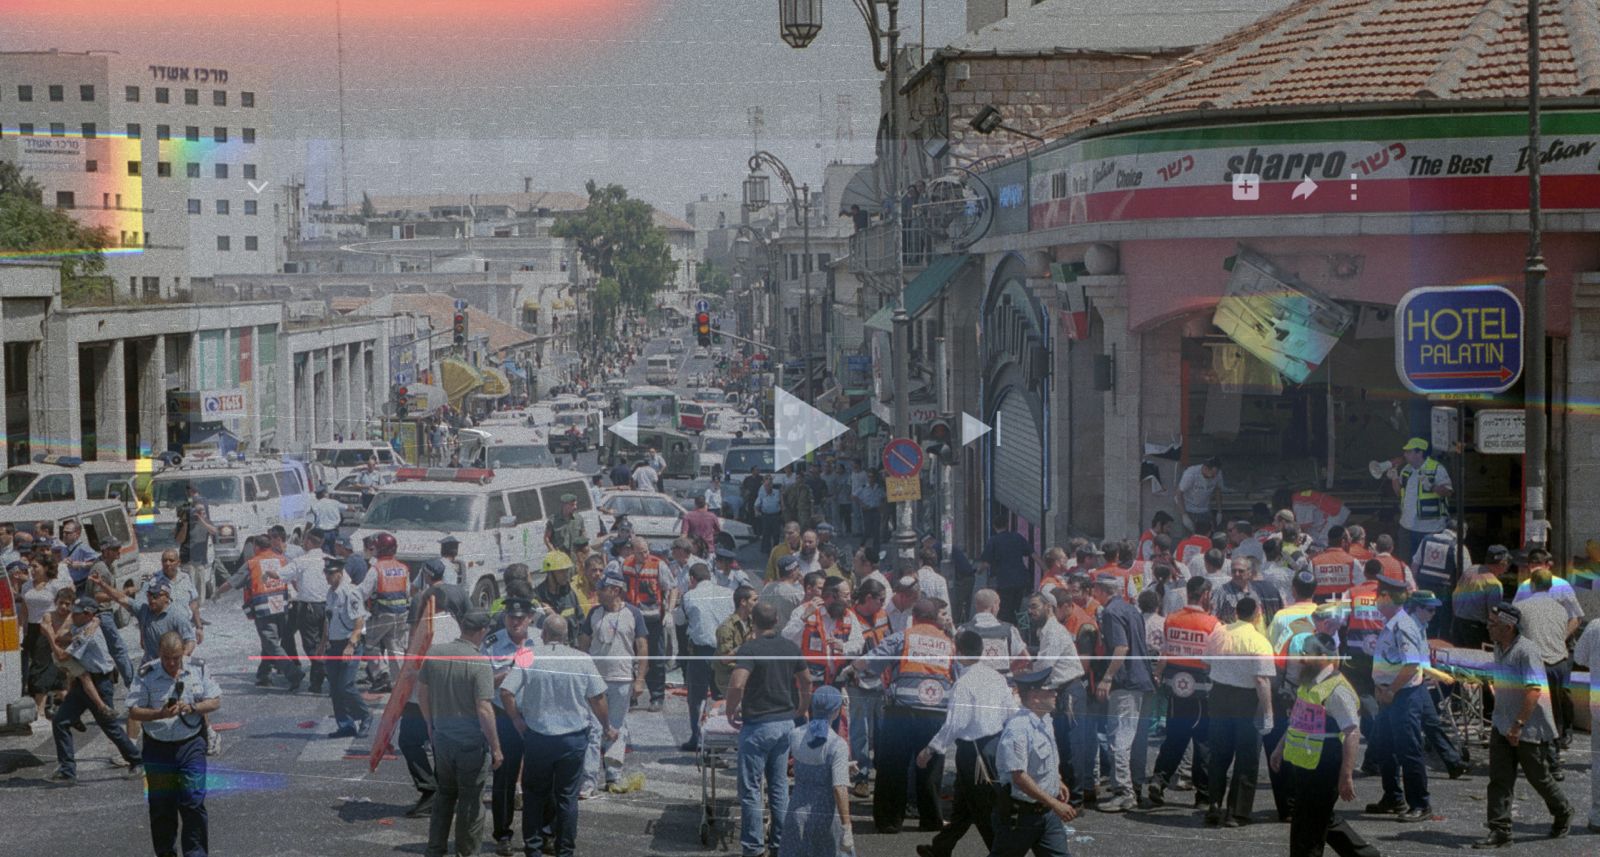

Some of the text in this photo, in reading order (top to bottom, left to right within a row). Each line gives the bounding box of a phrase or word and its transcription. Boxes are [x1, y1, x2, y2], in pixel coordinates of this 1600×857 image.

[148, 65, 228, 83] מרכז אשדר
[1157, 154, 1195, 182] כשר
[1223, 148, 1347, 182] sbarro
[1351, 142, 1407, 176] כשר
[1409, 155, 1443, 176] The
[1447, 154, 1494, 175] Best
[1514, 138, 1597, 173] Ialian
[1116, 169, 1144, 188] Choice
[1408, 307, 1518, 341] HOTEL
[1420, 342, 1505, 365] PALATIN
[1169, 629, 1204, 642] חובש
